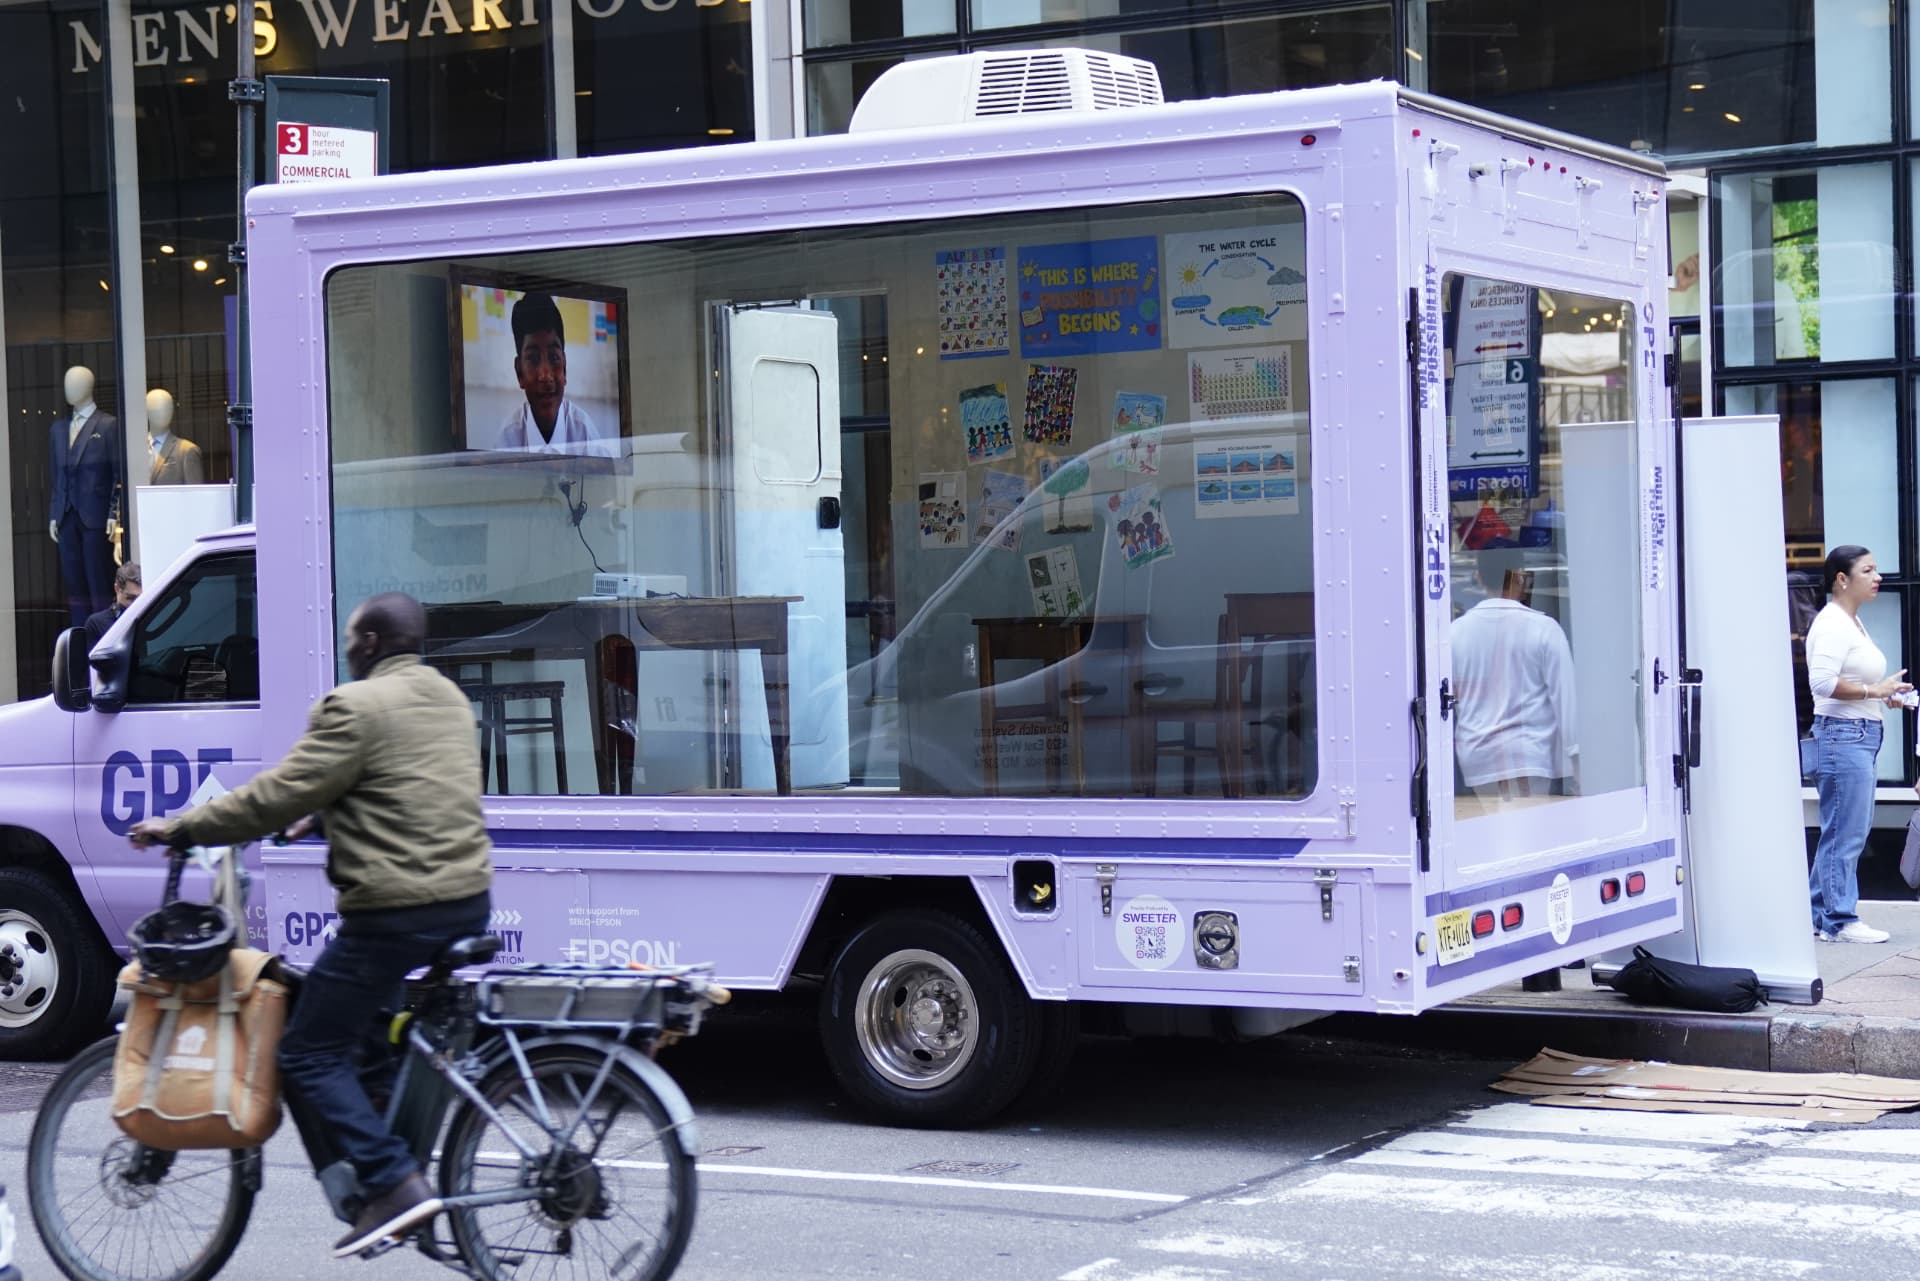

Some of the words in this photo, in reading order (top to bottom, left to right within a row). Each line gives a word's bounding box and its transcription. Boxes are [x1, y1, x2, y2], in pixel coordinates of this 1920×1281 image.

[285, 126, 302, 153] 3
[312, 129, 330, 138] hour
[312, 138, 345, 148] metered
[312, 149, 341, 158] parking
[282, 165, 352, 179] COMMERCIAL
[1199, 243, 1216, 253] THE
[1219, 240, 1246, 251] WATER
[1249, 237, 1277, 249] CYCLE
[1038, 267, 1069, 288] THIS
[1073, 266, 1087, 285] IS
[1091, 261, 1138, 282] WHERE
[1058, 310, 1121, 336] BEGINS
[1425, 264, 1439, 384] POSSIBILITY
[586, 907, 618, 918] support
[619, 907, 640, 916] from
[1122, 912, 1178, 924] SWEETER
